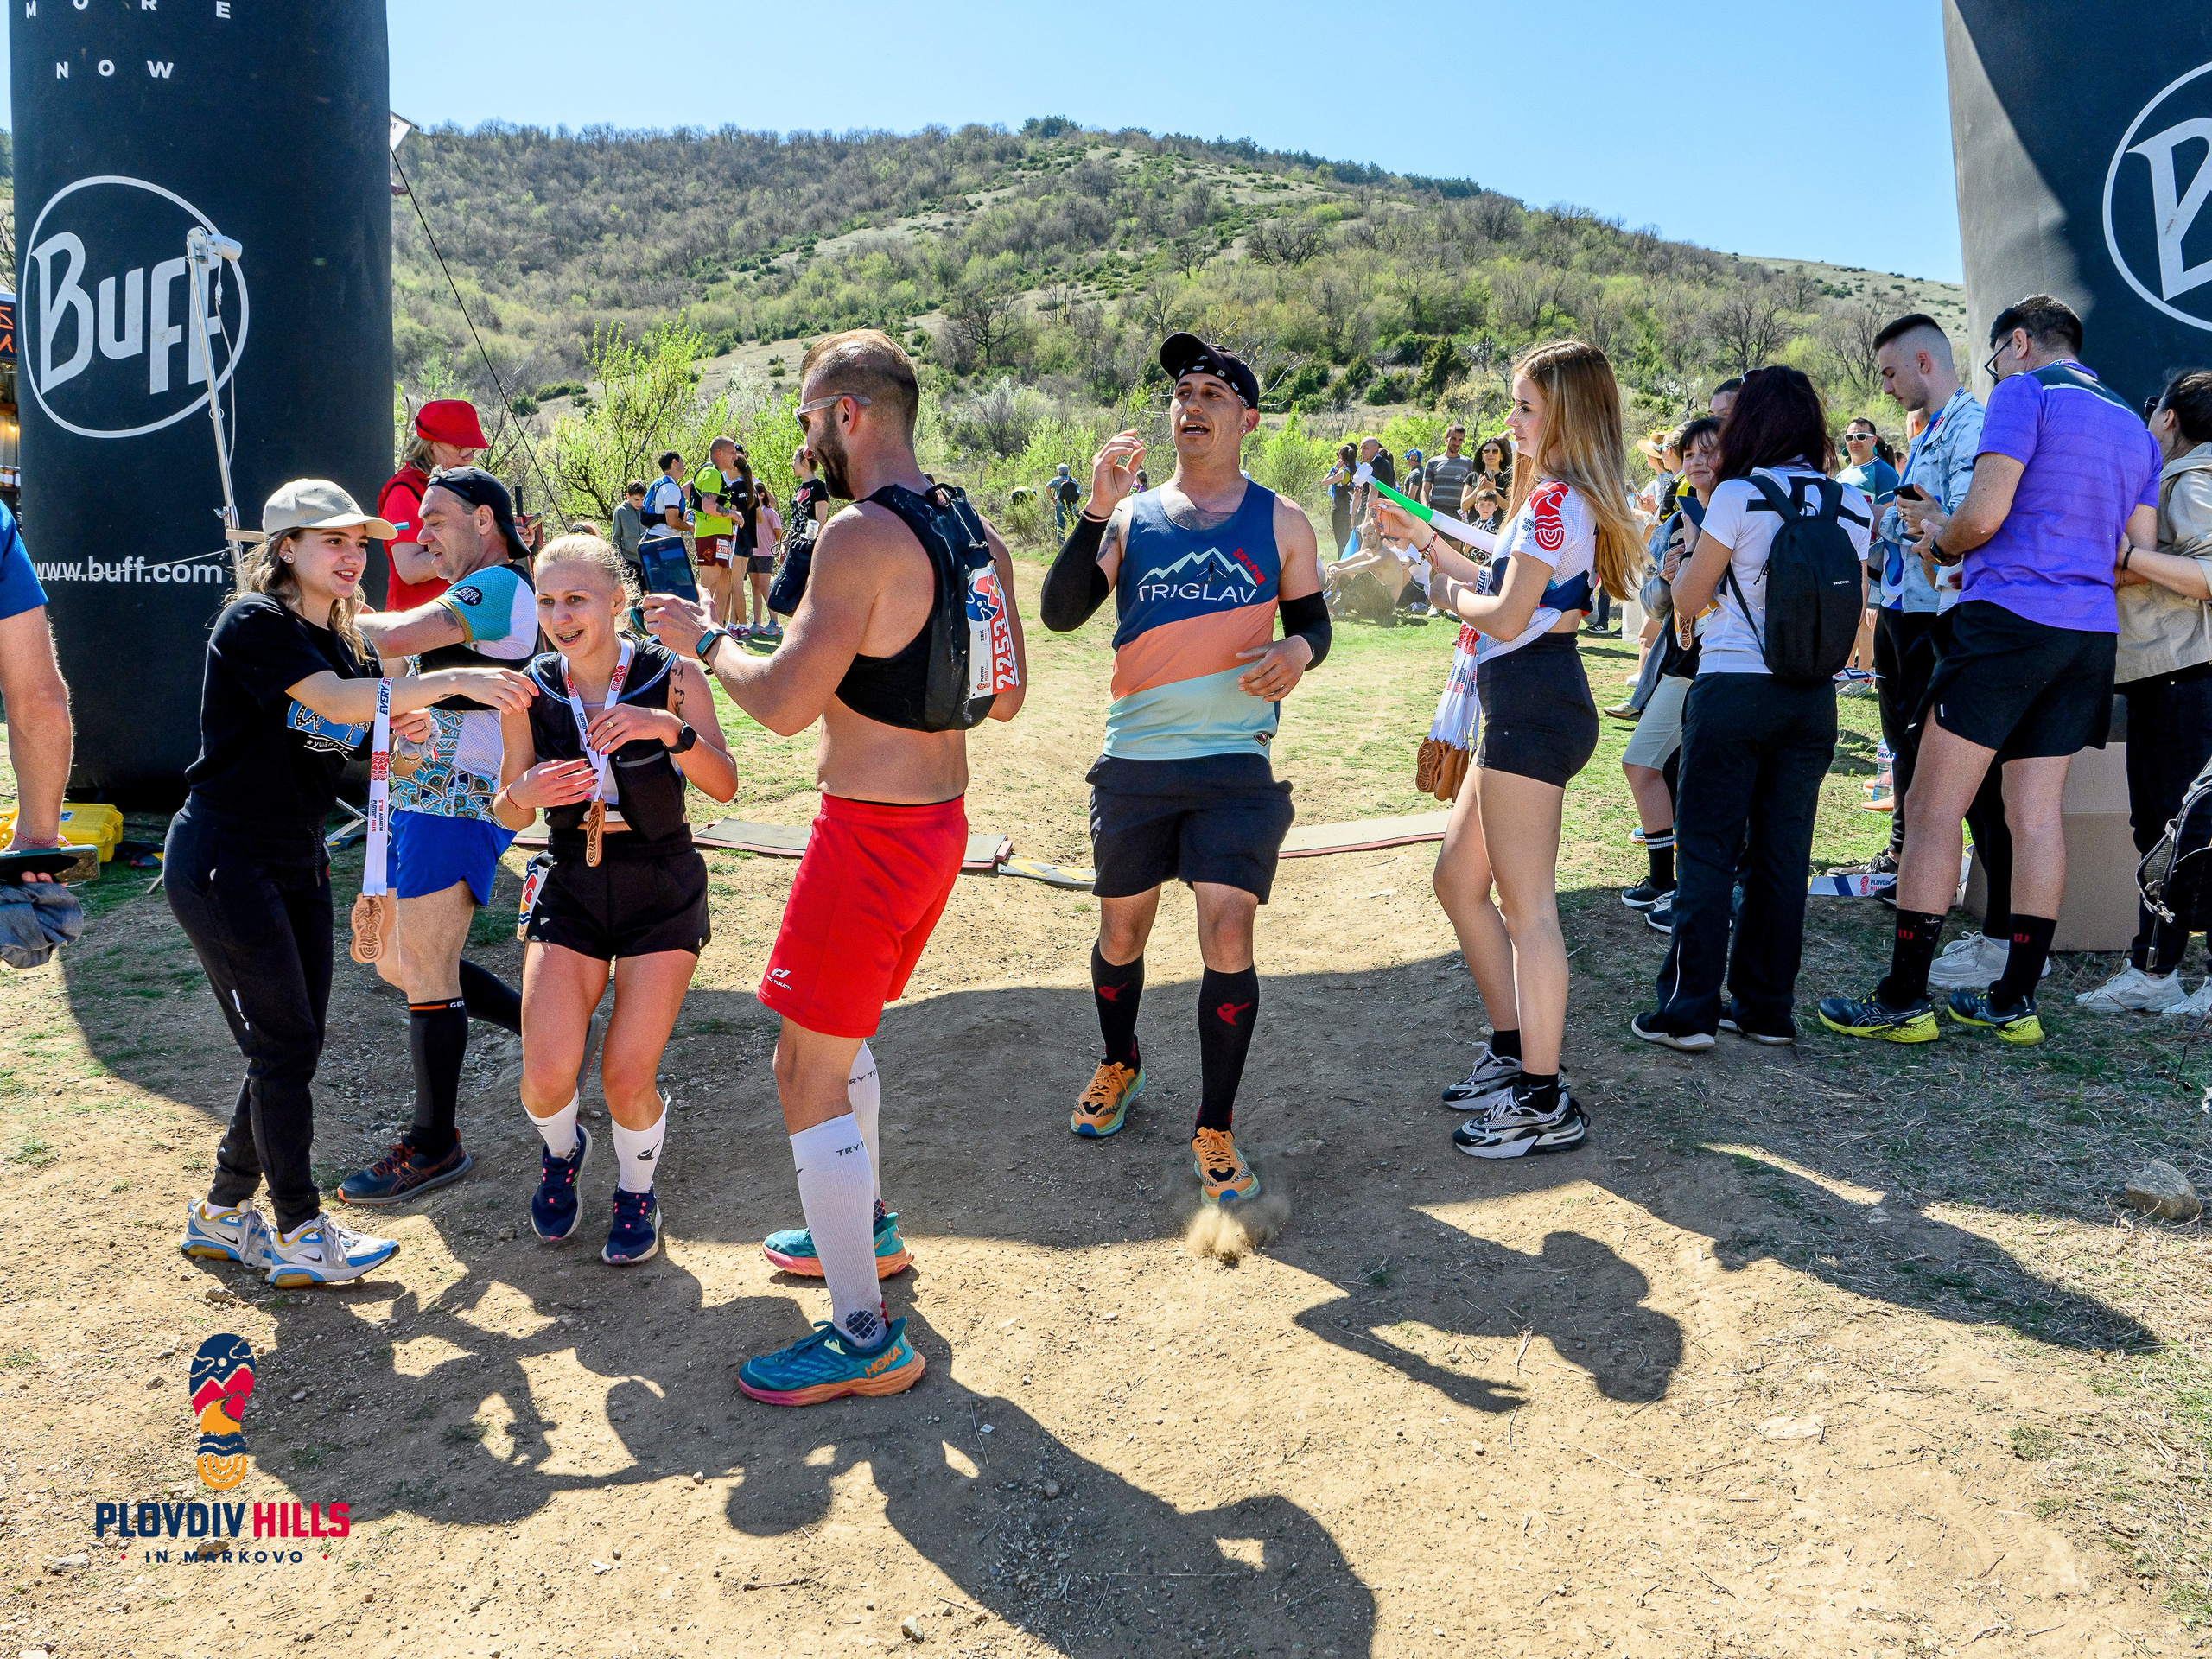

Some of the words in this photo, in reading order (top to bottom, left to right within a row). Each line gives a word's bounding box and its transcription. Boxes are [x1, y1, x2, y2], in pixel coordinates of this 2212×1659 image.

[55, 59, 175, 79] NOW
[1137, 582, 1258, 604] TRIGLAV
[993, 616, 1017, 690] 2253
[864, 1345, 902, 1378] HOKA
